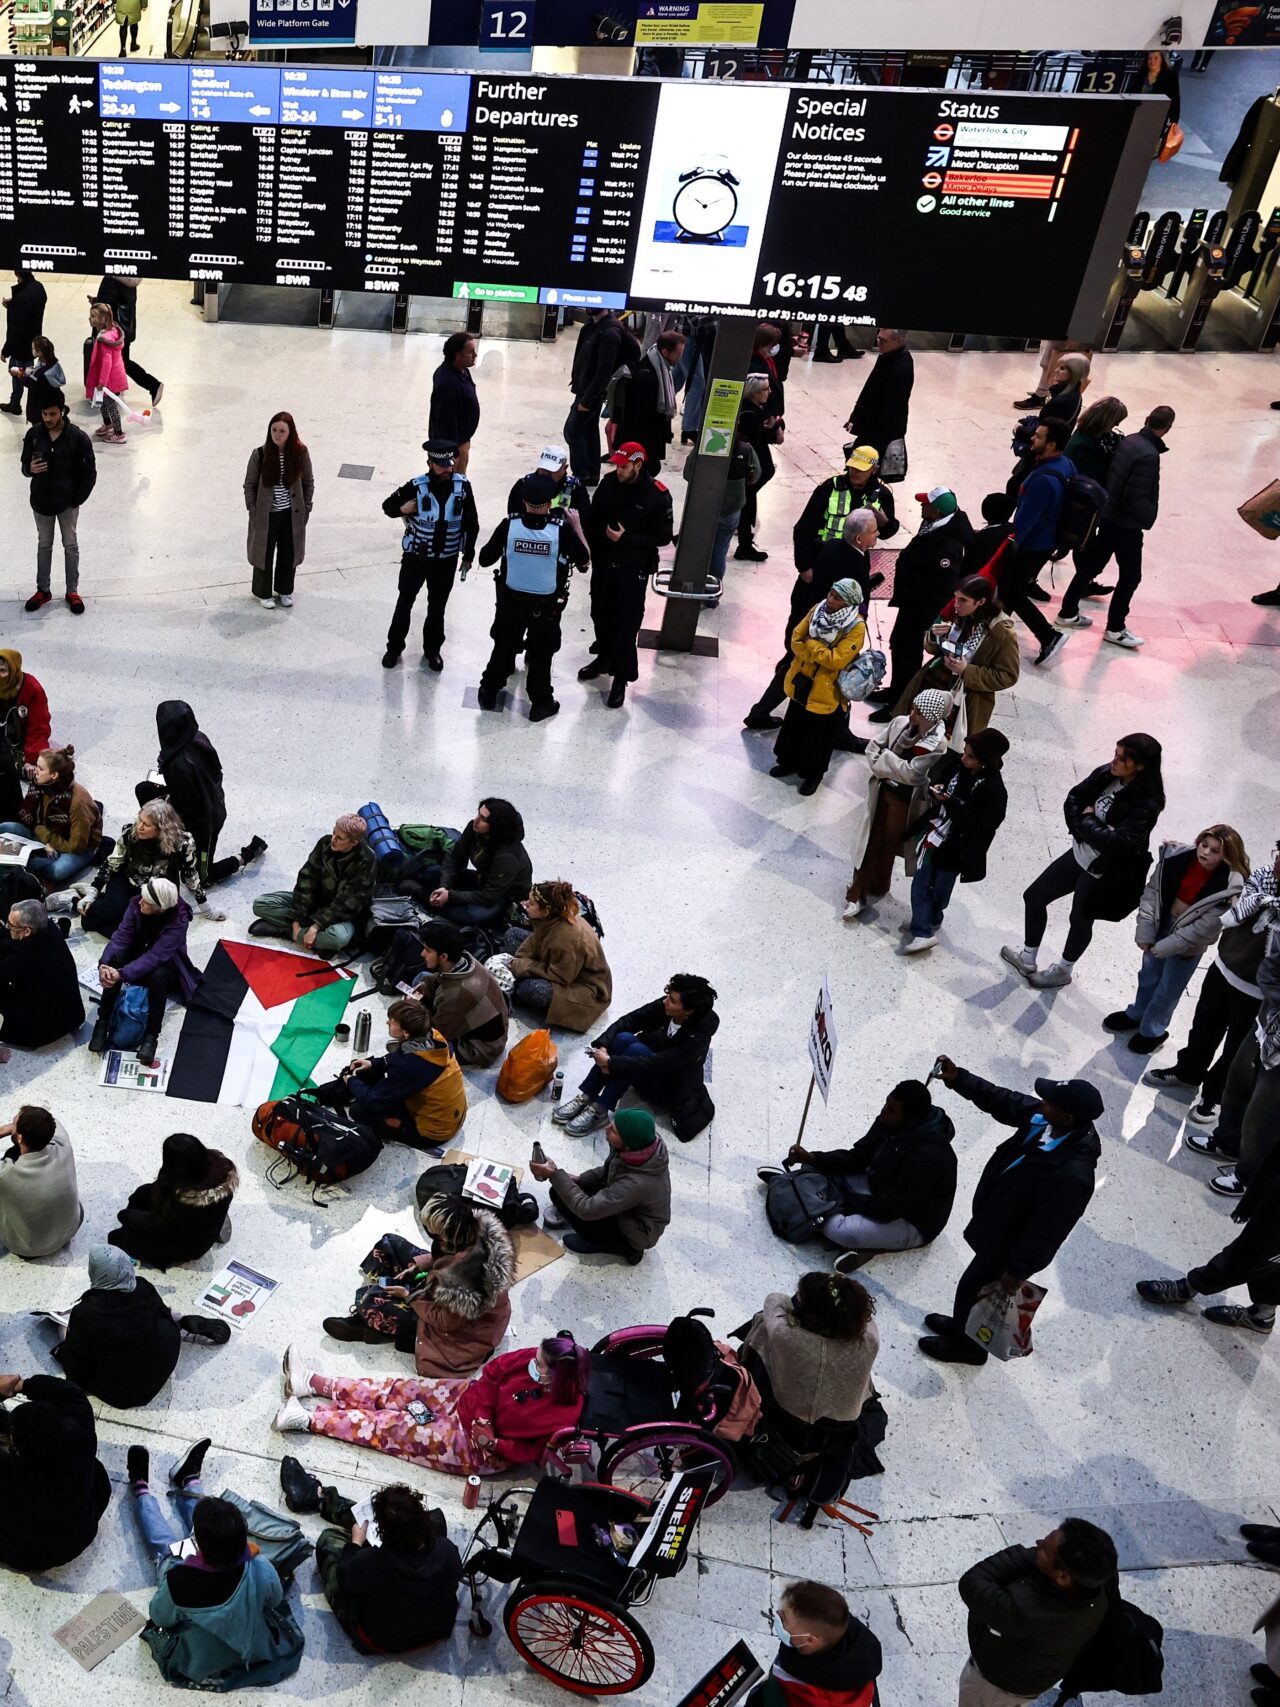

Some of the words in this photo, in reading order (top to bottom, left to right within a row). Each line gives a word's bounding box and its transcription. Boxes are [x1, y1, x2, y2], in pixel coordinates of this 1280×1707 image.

[257, 19, 276, 28] Wide
[278, 18, 310, 28] Platform
[312, 19, 329, 28] Gate
[490, 11, 528, 38] 12
[708, 60, 738, 80] 12
[1082, 72, 1116, 93] 13
[478, 81, 547, 100] Further
[16, 100, 30, 112] 15
[102, 103, 136, 116] 20-24
[796, 97, 866, 118] Special
[938, 100, 1000, 118] Status
[282, 110, 317, 122] 20-24
[375, 113, 402, 126] 5-11
[476, 107, 578, 128] Departures
[792, 122, 865, 142] Notices
[1012, 128, 1029, 136] City
[802, 152, 822, 160] doors
[824, 154, 842, 162] close
[954, 150, 979, 158] South
[980, 150, 1018, 160] Western
[1018, 152, 1058, 162] Mainline
[812, 162, 847, 171] departure
[951, 160, 976, 168] Minor
[976, 161, 1020, 172] Disruption
[861, 174, 876, 182] help
[948, 174, 988, 182] Bakerloo
[844, 182, 878, 190] clockwork
[946, 184, 968, 192] Minor
[970, 185, 998, 194] Delays
[942, 196, 957, 205] All
[958, 196, 985, 207] other
[989, 198, 1014, 208] lines
[940, 208, 962, 216] Good
[963, 210, 991, 218] service
[1164, 219, 1173, 235] Uber
[1161, 232, 1169, 243] on
[1234, 243, 1242, 258] now
[1244, 218, 1252, 234] Uber
[1156, 242, 1164, 258] now
[763, 272, 841, 300] 16:15
[843, 286, 867, 301] 48
[665, 302, 686, 312] SWR
[688, 304, 708, 314] Line
[711, 306, 756, 318] Problems
[797, 312, 816, 322] Due
[818, 313, 828, 322] to
[837, 314, 876, 326] signallin
[544, 452, 558, 460] POLICE
[516, 541, 549, 550] POLICE
[656, 1487, 693, 1557] SIEGE
[668, 1524, 686, 1560] THE
[56, 1616, 90, 1646] FREE
[72, 1602, 138, 1660] PALESTINE
